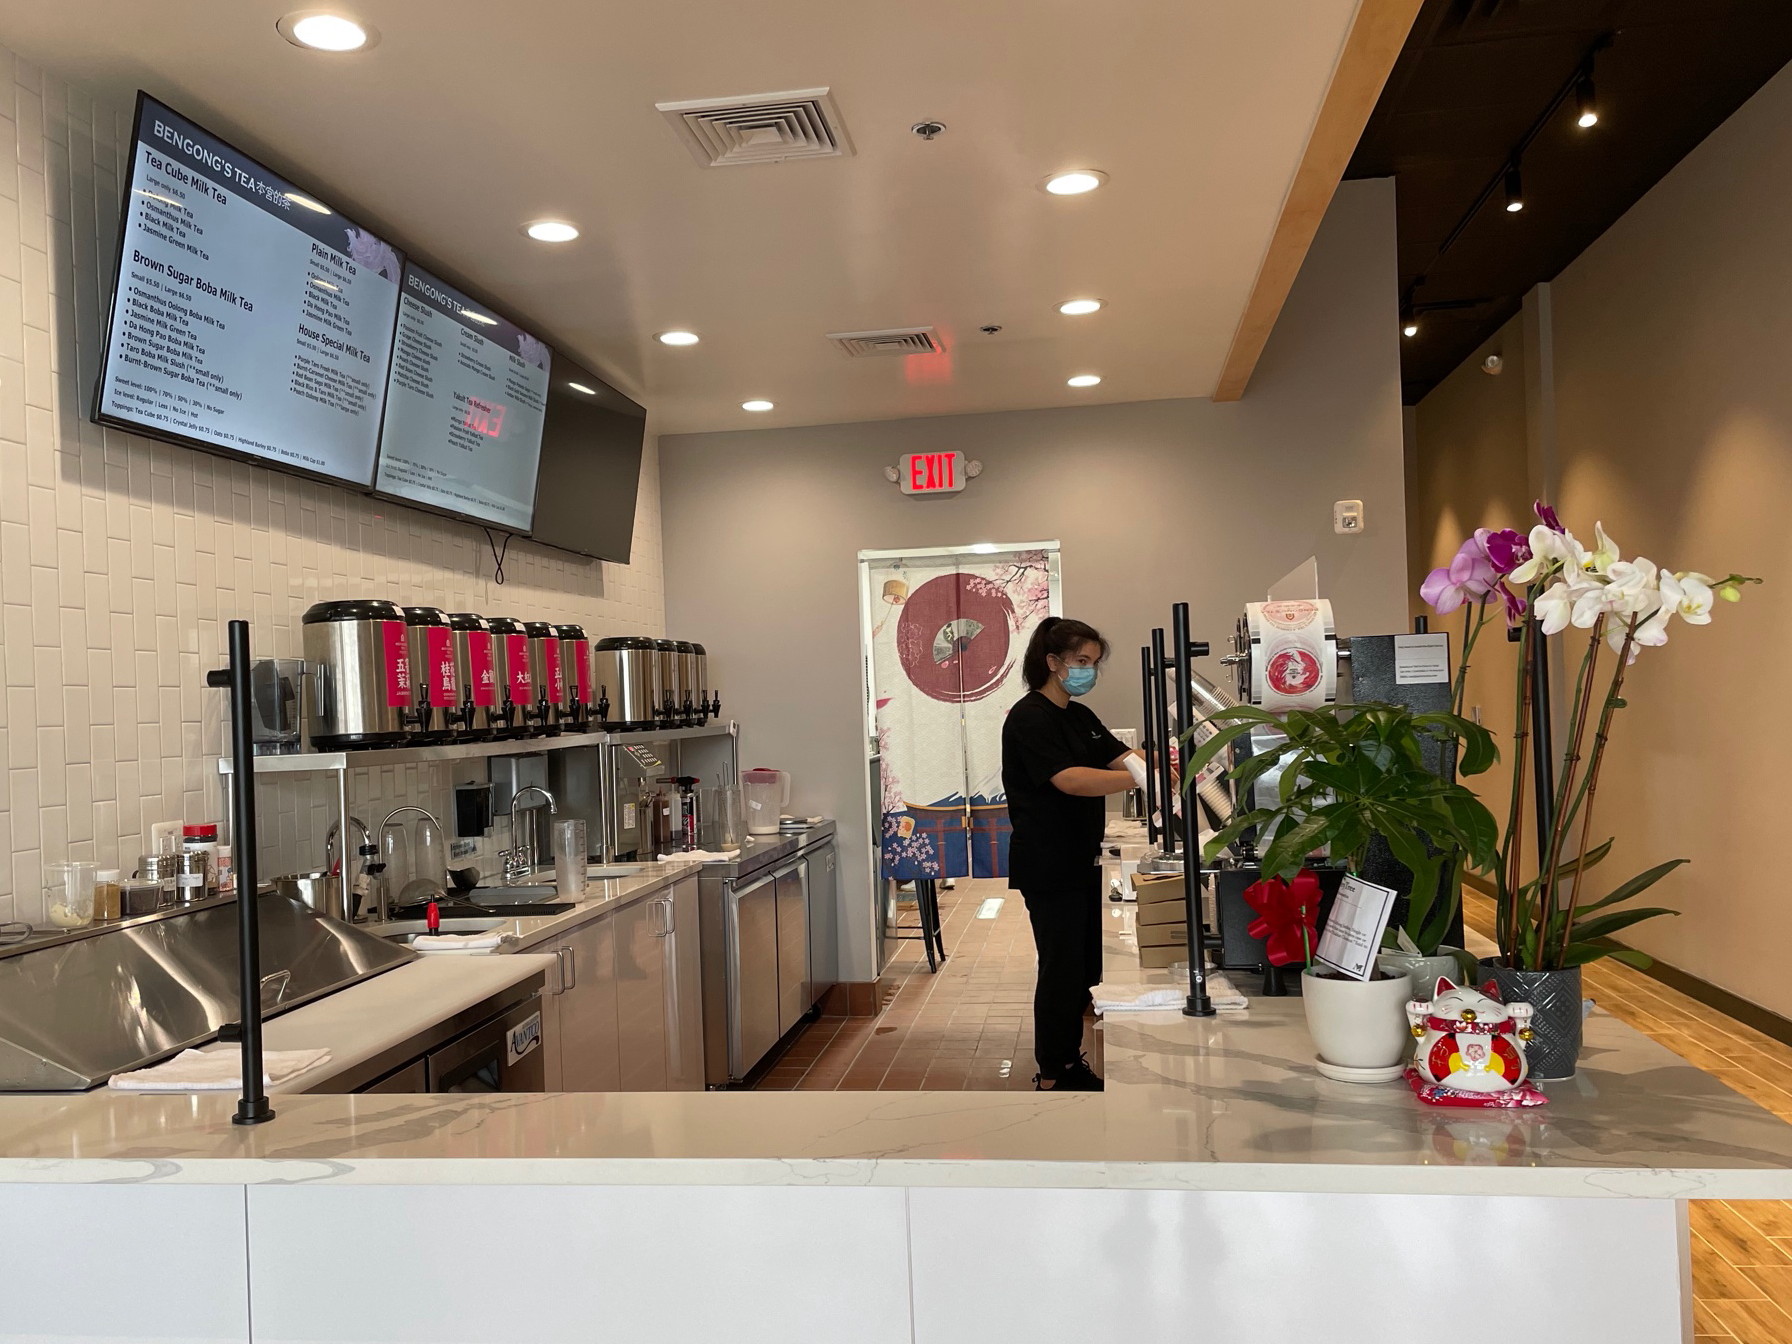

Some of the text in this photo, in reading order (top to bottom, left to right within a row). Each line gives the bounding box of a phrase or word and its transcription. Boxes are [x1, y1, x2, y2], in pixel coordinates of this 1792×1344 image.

[153, 119, 232, 178] BENGONG'S
[233, 166, 256, 192] TEA
[144, 150, 227, 205] Tea Cube Milk Tea
[146, 174, 160, 188] Large
[160, 181, 171, 194] only
[144, 212, 185, 238] Black Milk Tea
[146, 200, 203, 235] Osmanthus Milk Tea
[183, 208, 193, 219] Tea
[142, 223, 209, 261] Jasmine Green Milk Tea
[311, 242, 356, 276] Plain Milk Tea
[131, 271, 144, 282] Small
[164, 285, 177, 297] Large
[132, 249, 253, 312] Brown Sugar Boba Milk Tea
[408, 274, 452, 309] BENGONG'S
[131, 298, 188, 326] Black Boba Milk Tea
[133, 287, 225, 330] Osmanthus Oolong Boba Milk Tea
[403, 296, 420, 311] Cheese
[420, 305, 432, 318] Slush
[128, 320, 205, 355] Da Hong Pao Boba Milk Tea
[130, 309, 197, 341] Jasmine Milk Green Tea
[125, 342, 139, 354] Taro
[140, 348, 155, 359] Boba
[157, 353, 169, 364] Milk
[170, 358, 185, 369] Slush
[127, 331, 202, 364] Brown Sugar Boba Milk Tea
[298, 323, 370, 363] House Special Milk Tea
[124, 354, 162, 373] Burnt-Brown
[162, 367, 179, 380] Sugar
[180, 373, 194, 384] Boba
[195, 378, 205, 387] Tea
[911, 453, 956, 491] EXIT
